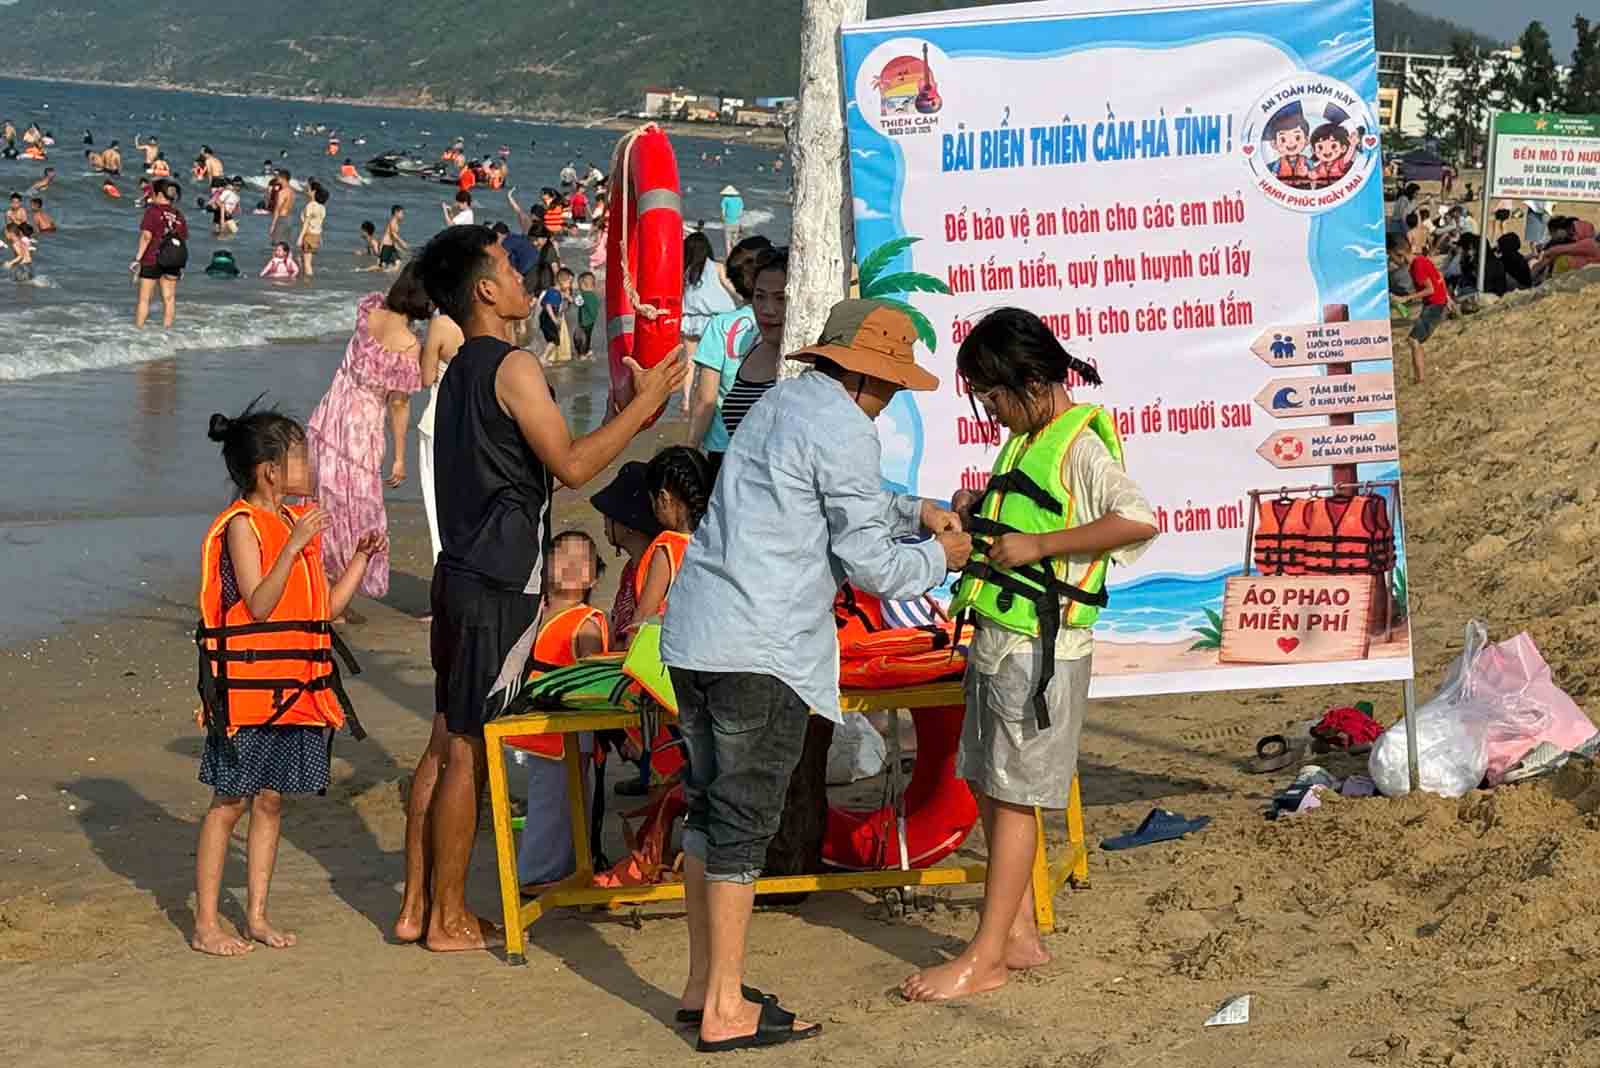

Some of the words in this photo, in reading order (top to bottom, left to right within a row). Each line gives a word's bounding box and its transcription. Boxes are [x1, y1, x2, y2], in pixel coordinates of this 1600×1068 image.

[1261, 97, 1276, 113] AN
[1276, 85, 1304, 102] TOÀN
[1307, 83, 1333, 96] HÔM
[1334, 91, 1357, 106] NAY
[942, 122, 974, 172] BÃI
[980, 106, 1025, 169] BIỂN
[1030, 114, 1087, 167] THIÊN
[1092, 101, 1170, 162] CẦM-HÀ
[1174, 106, 1221, 156] TĨNH
[1287, 193, 1316, 207] PHÚC
[1318, 188, 1344, 206] NGÀY
[1345, 175, 1364, 193] MAI
[944, 205, 968, 242] Để
[973, 208, 1004, 241] bảo
[1010, 208, 1030, 244] vệ
[1036, 212, 1057, 236] an
[1062, 203, 1100, 234] toàn
[1106, 203, 1137, 231] cho
[1143, 198, 1175, 229] các
[1180, 201, 1208, 227] em
[1213, 190, 1245, 225] nhỏ
[948, 264, 976, 293] khi
[980, 255, 1014, 292] tắm
[1019, 251, 1063, 290] biển,
[1068, 254, 1098, 288] quý
[1104, 254, 1136, 288] phụ
[1141, 249, 1194, 283] huynh
[1199, 246, 1220, 277] cứ
[1225, 240, 1251, 278] lấy
[1076, 307, 1093, 342] bị
[1098, 305, 1130, 335] cho
[1136, 301, 1167, 332] các
[1173, 298, 1216, 330] cháu
[1220, 290, 1253, 327] tắm
[1326, 328, 1340, 338] EM
[1113, 407, 1135, 442] lại
[1141, 397, 1162, 434] để
[1167, 400, 1216, 434] người
[1221, 403, 1252, 428] sau
[1350, 432, 1376, 442] PHAO
[1174, 498, 1211, 533] cảm
[1217, 498, 1245, 529] ơn!
[1242, 584, 1276, 606] ÁO
[1282, 588, 1351, 606] PHAO
[1238, 606, 1300, 630] MIỄN
[1306, 608, 1350, 632] PHÍ
